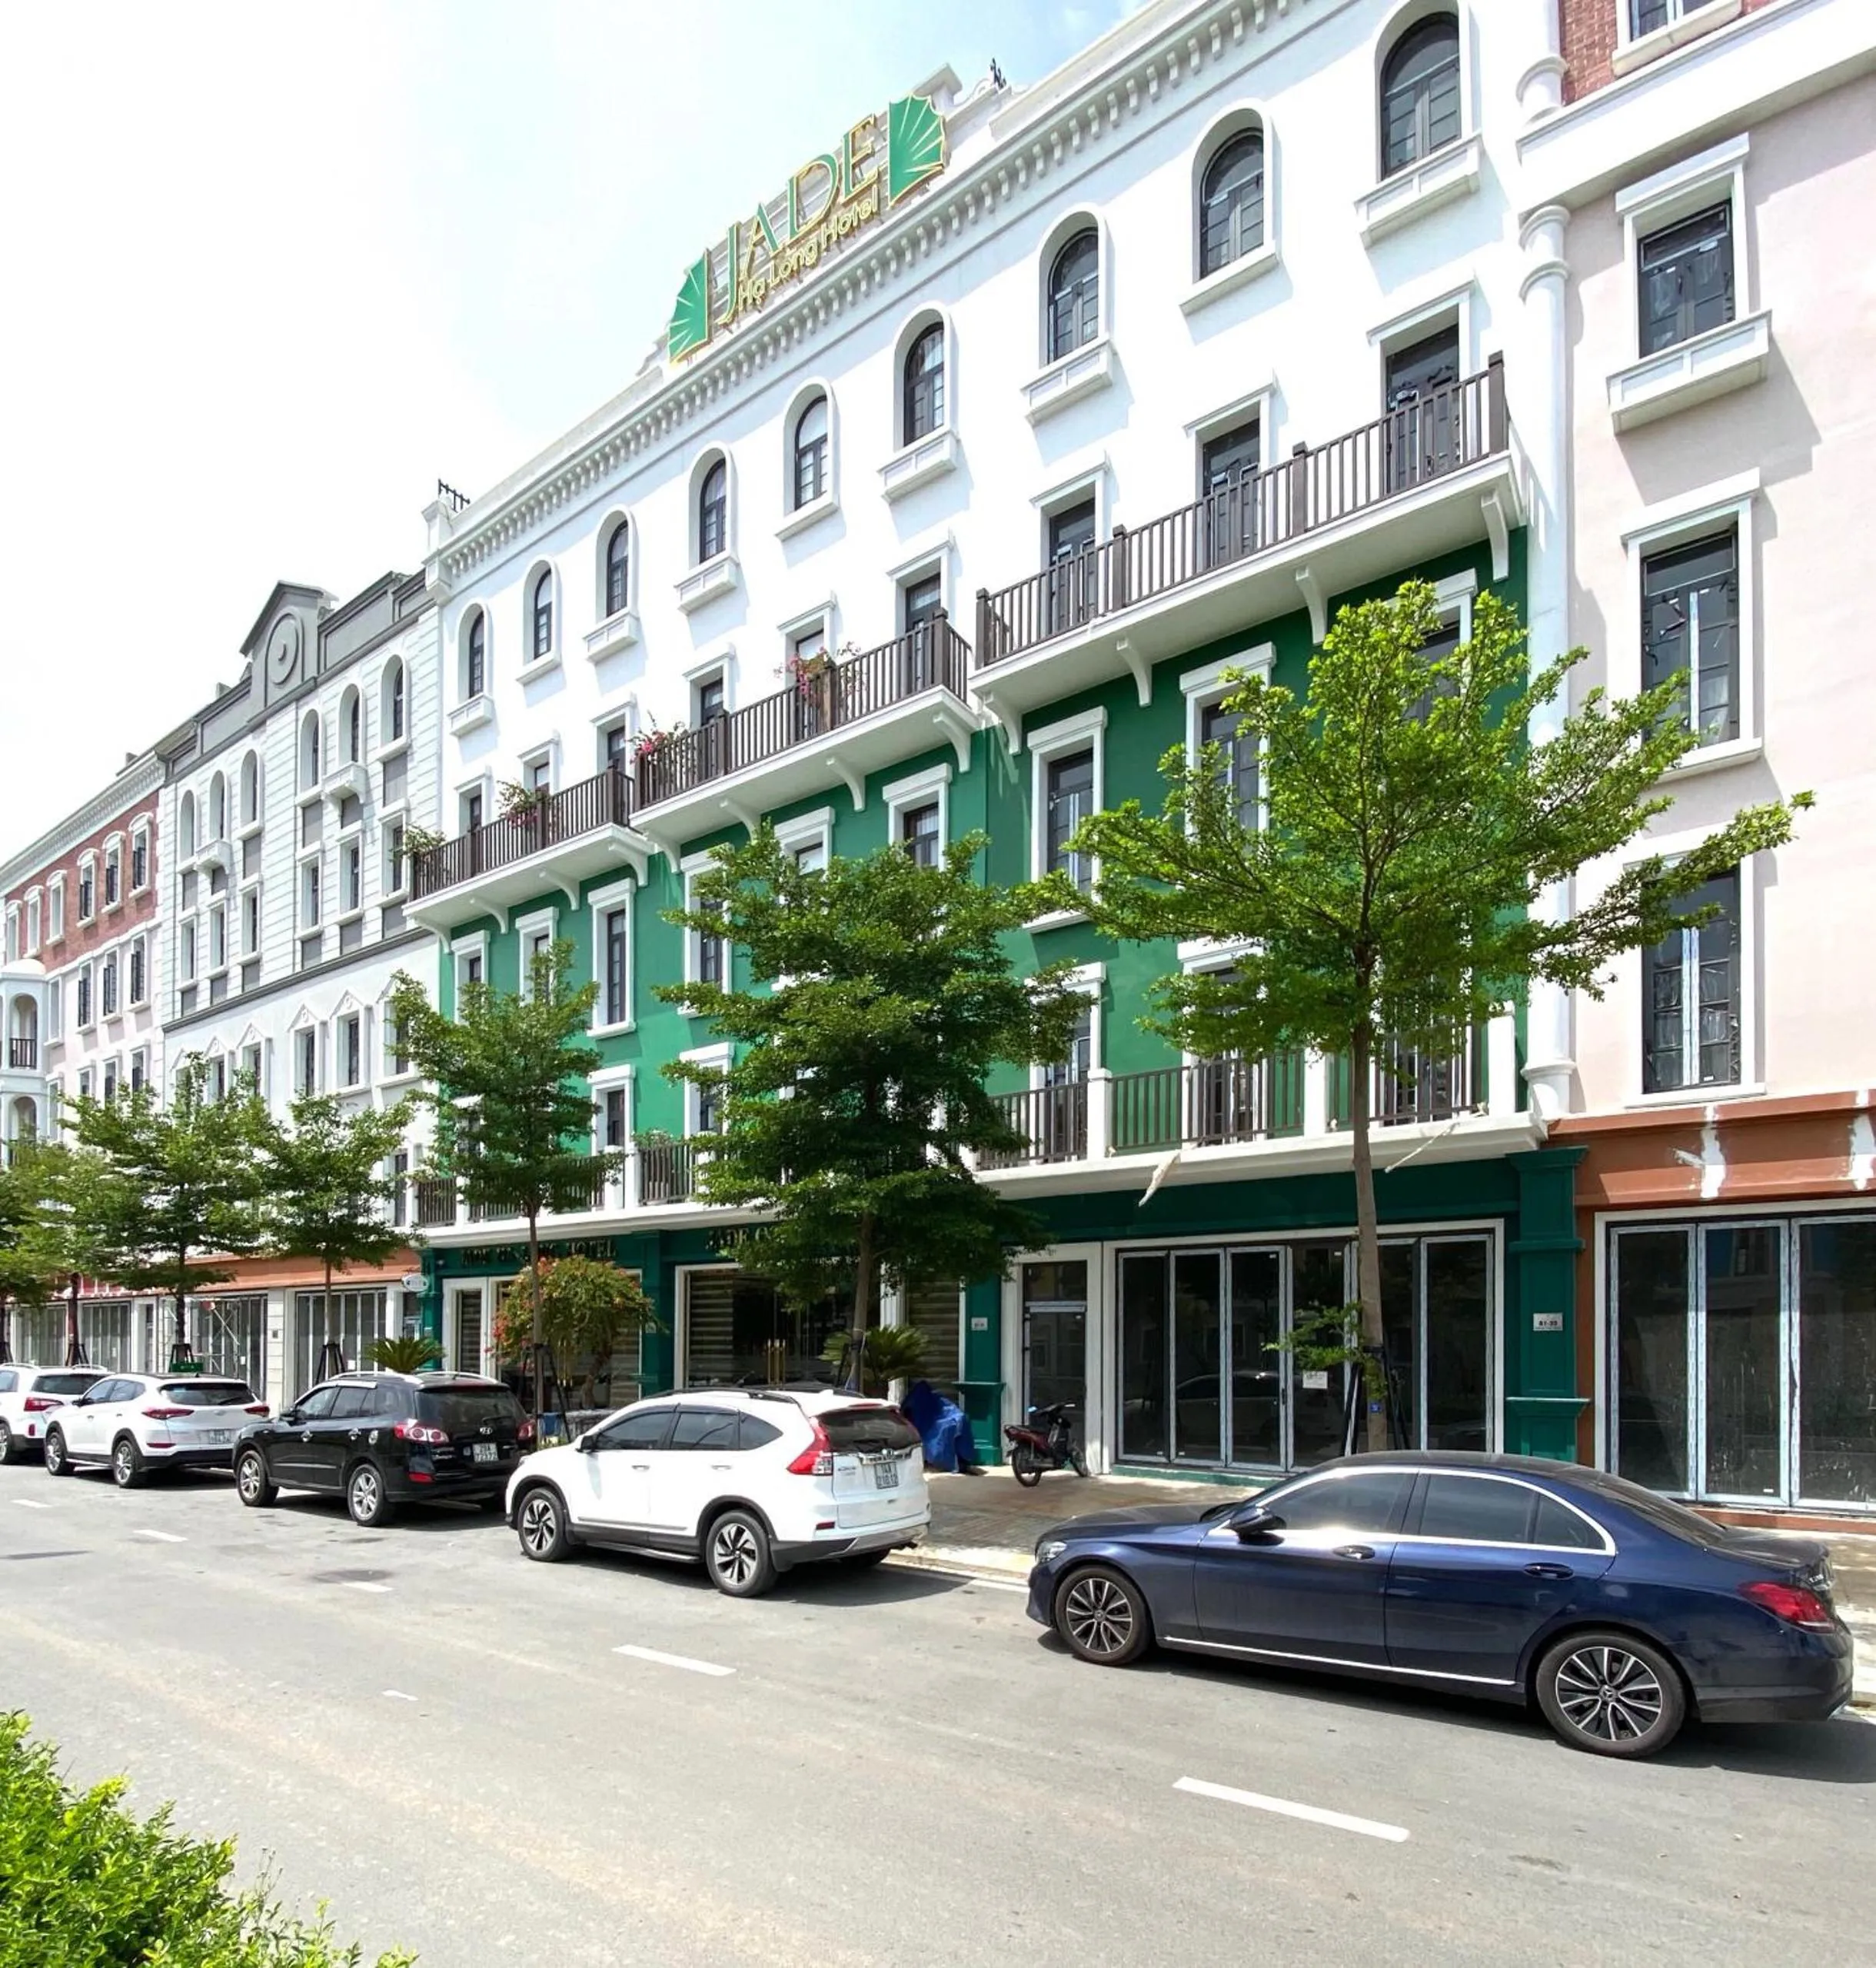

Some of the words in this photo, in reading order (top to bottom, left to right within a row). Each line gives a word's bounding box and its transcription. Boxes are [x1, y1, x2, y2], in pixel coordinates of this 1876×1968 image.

[713, 113, 879, 325] JADE
[738, 278, 767, 311] Hạ
[769, 238, 820, 288] Long
[820, 185, 880, 251] Hotel
